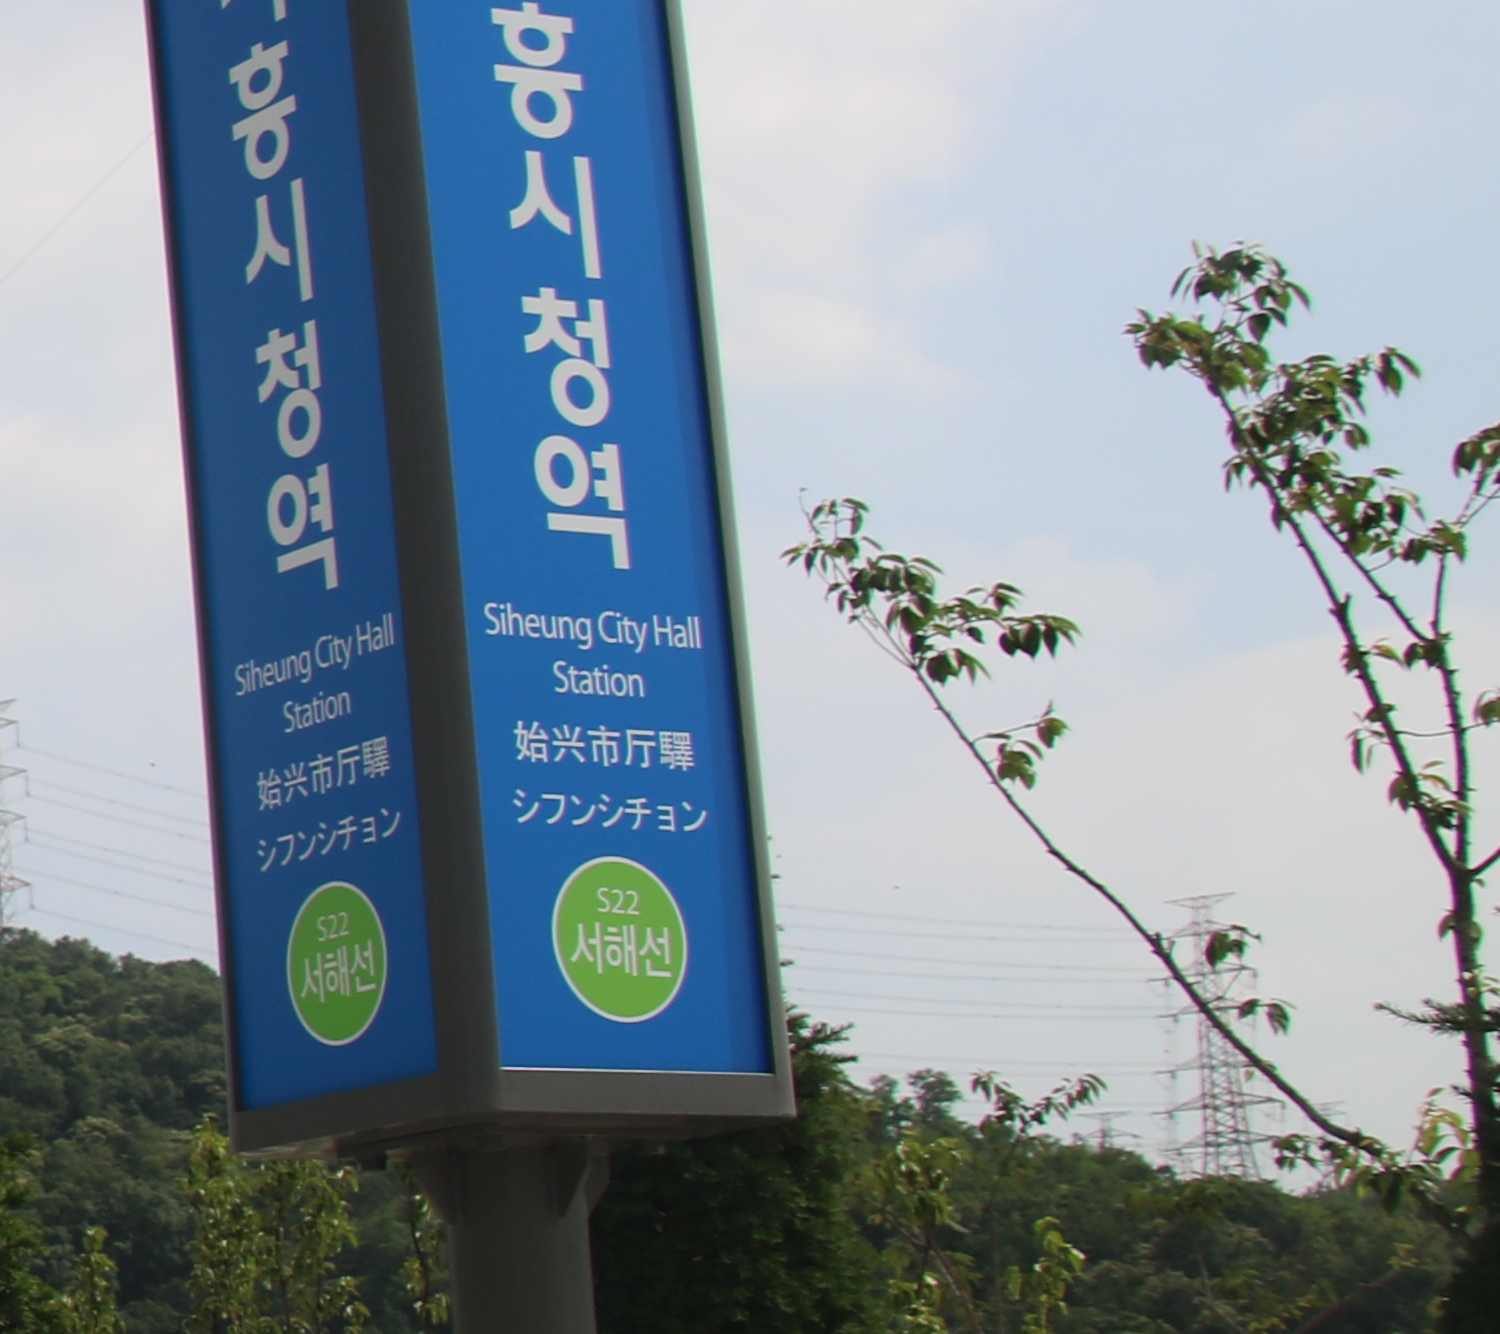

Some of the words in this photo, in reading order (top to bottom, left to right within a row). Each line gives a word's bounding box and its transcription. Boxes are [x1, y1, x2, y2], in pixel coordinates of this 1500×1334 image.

[484, 602, 594, 651] Siheung
[597, 610, 649, 654] City
[652, 615, 702, 649] Hall
[235, 650, 313, 697] Siheung
[315, 634, 353, 670] City
[356, 612, 395, 656] Hall
[553, 660, 646, 698] Station
[283, 691, 351, 734] Station
[513, 789, 708, 832] シフンシチョン
[257, 807, 402, 873] シフンシチョン
[596, 886, 641, 915] S22
[316, 911, 350, 942] S22
[300, 939, 376, 1003] 서해선
[570, 922, 673, 979] 서해선
